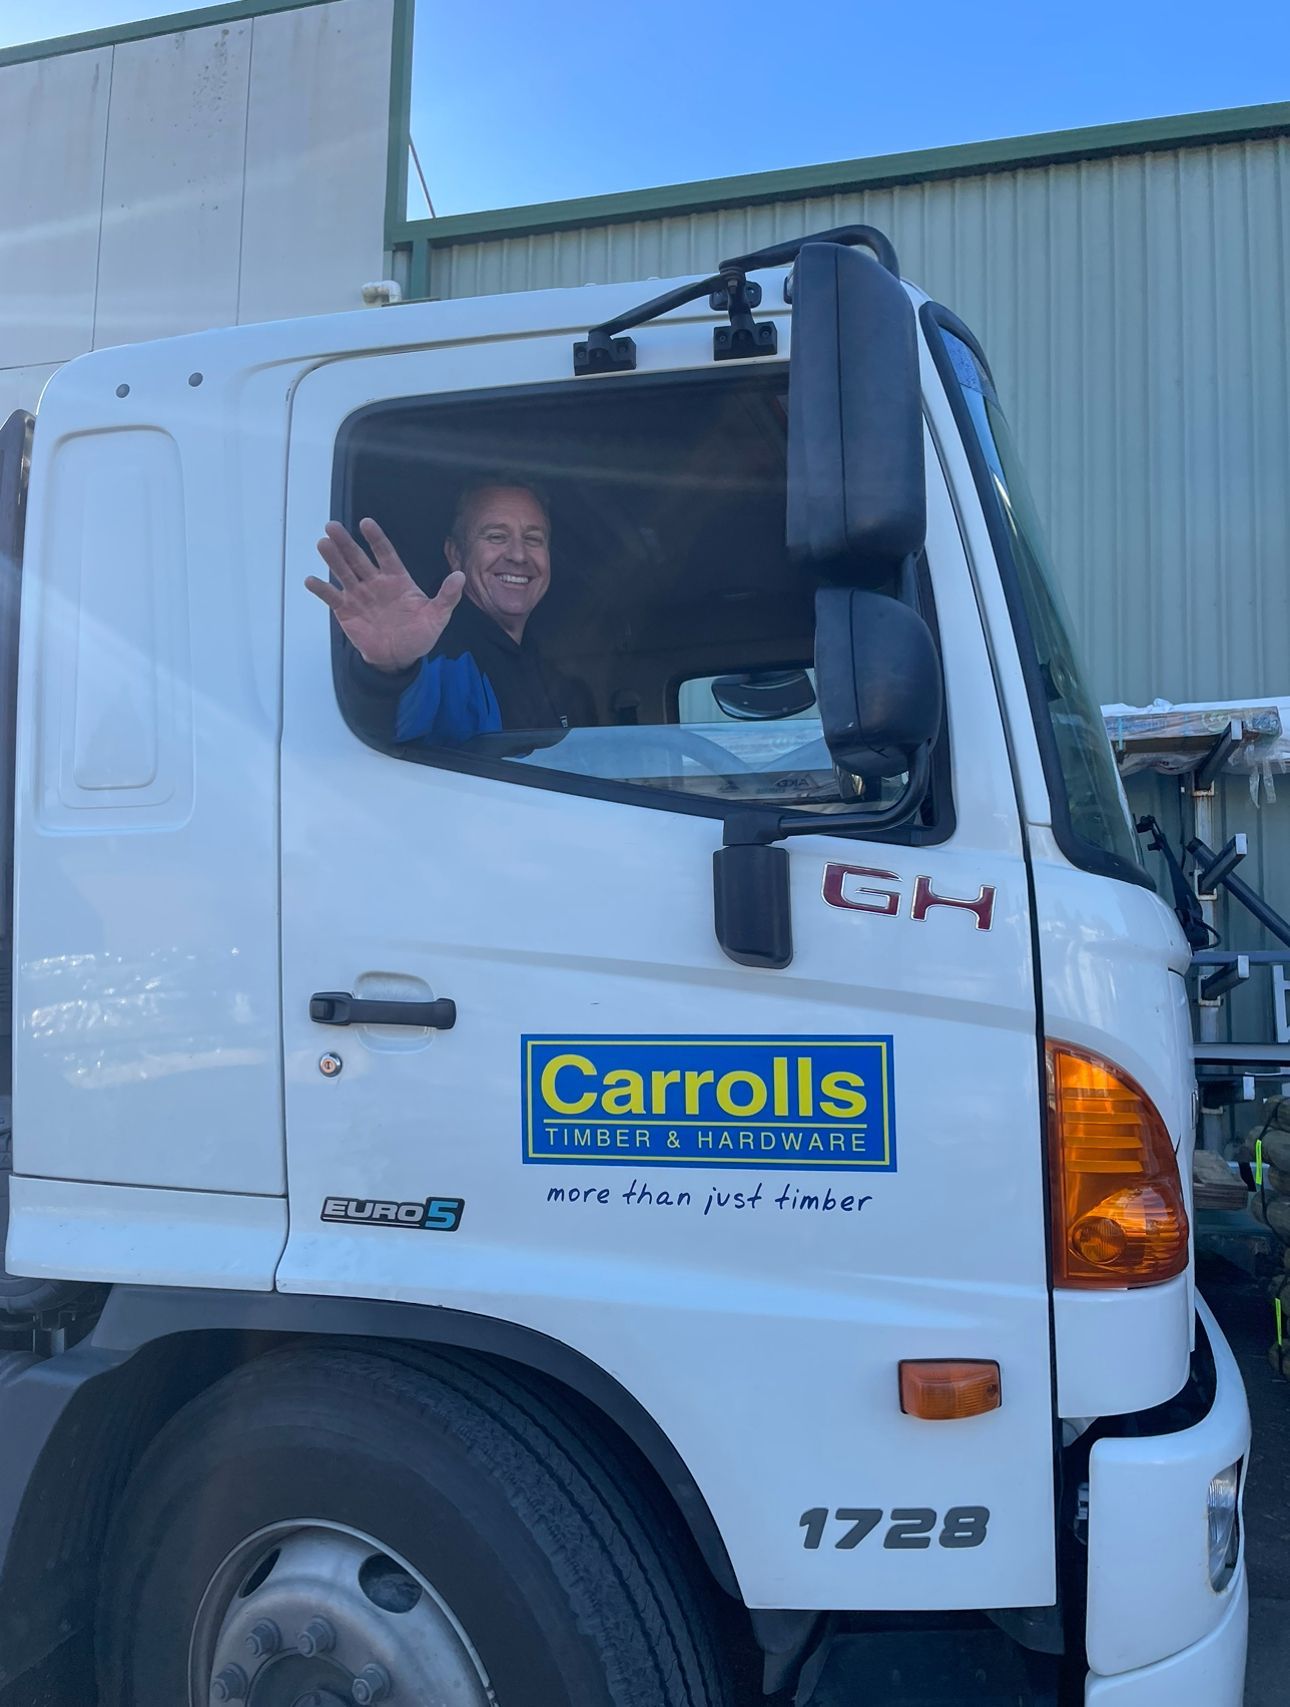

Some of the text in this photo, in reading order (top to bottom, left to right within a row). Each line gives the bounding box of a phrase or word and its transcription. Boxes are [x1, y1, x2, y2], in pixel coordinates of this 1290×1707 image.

[821, 862, 997, 932] GH
[540, 1053, 867, 1118] Carrolls
[545, 1128, 867, 1152] TIMBER & HARDWARE
[547, 1179, 873, 1215] more than just timber
[799, 1505, 990, 1550] 1728
